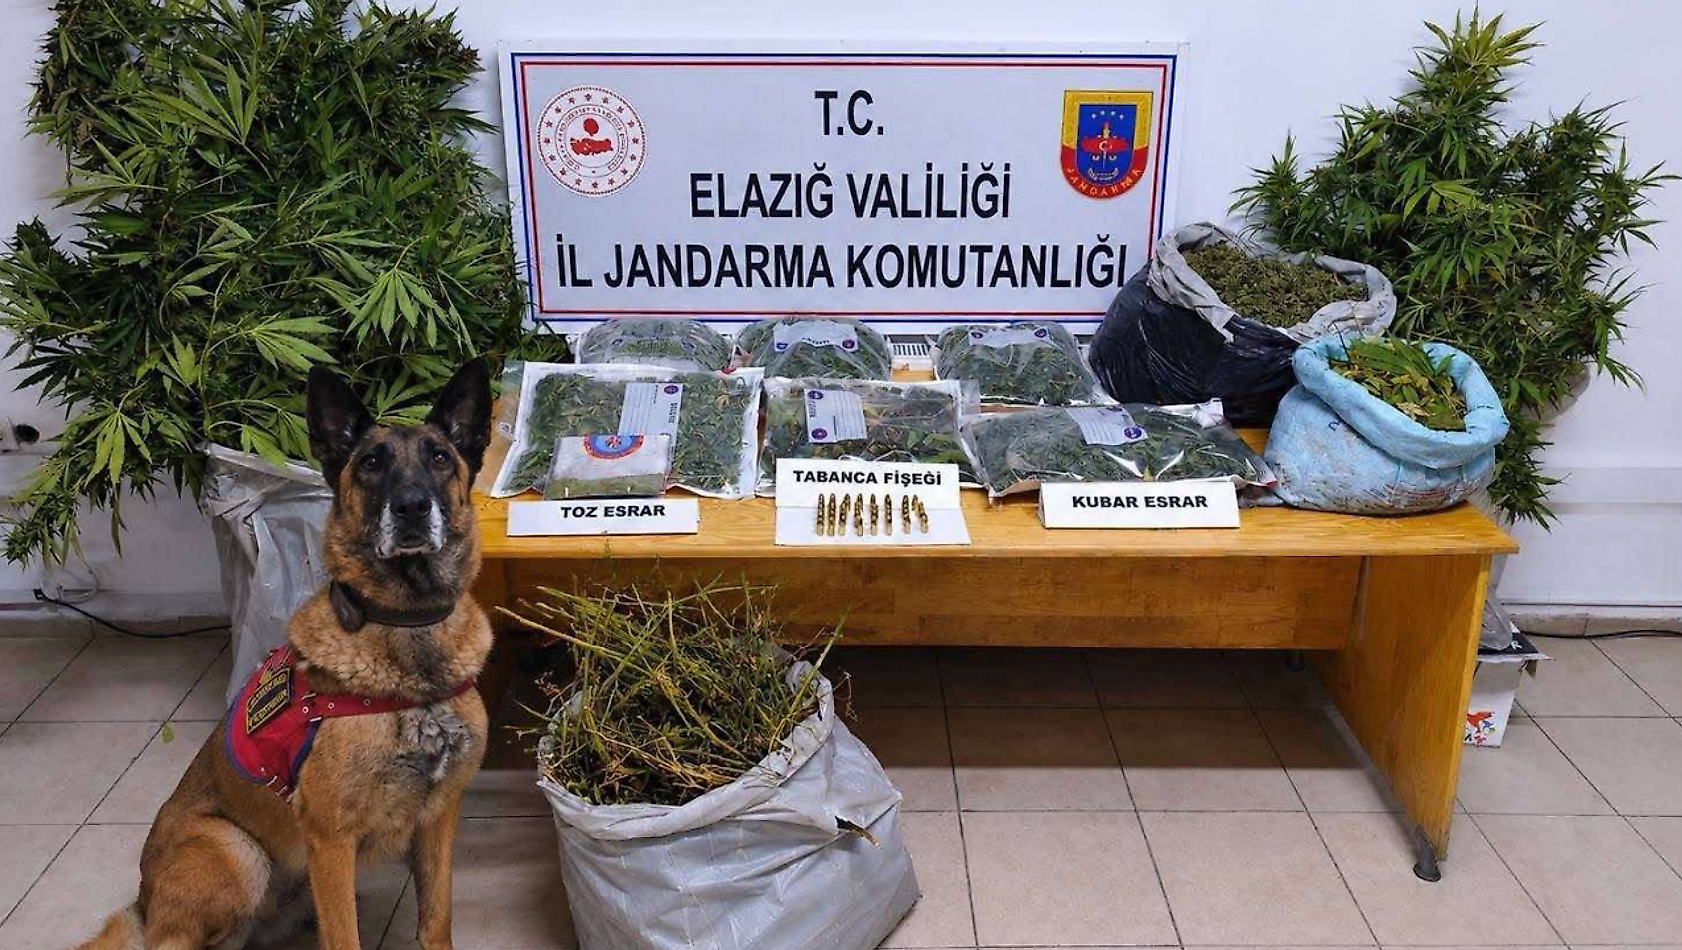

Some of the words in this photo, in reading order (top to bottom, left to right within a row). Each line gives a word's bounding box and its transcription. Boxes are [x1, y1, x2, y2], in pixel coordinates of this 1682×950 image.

[814, 89, 884, 136] T.C.
[690, 162, 834, 219] ELAZIĞ
[846, 162, 1011, 219] VALİLİĞİ
[1067, 168, 1141, 196] JANDARMA
[556, 233, 593, 288] İL
[603, 244, 835, 289] JANDARMA
[847, 233, 1127, 289] KOMUTANLIĞI
[792, 470, 878, 484] TABANCA
[883, 470, 941, 487] FİŞEĞİ
[560, 506, 598, 519] TOZ
[603, 505, 666, 518] ESRAR
[1072, 495, 1139, 508] KUBAR
[1144, 495, 1208, 508] ESRAR
